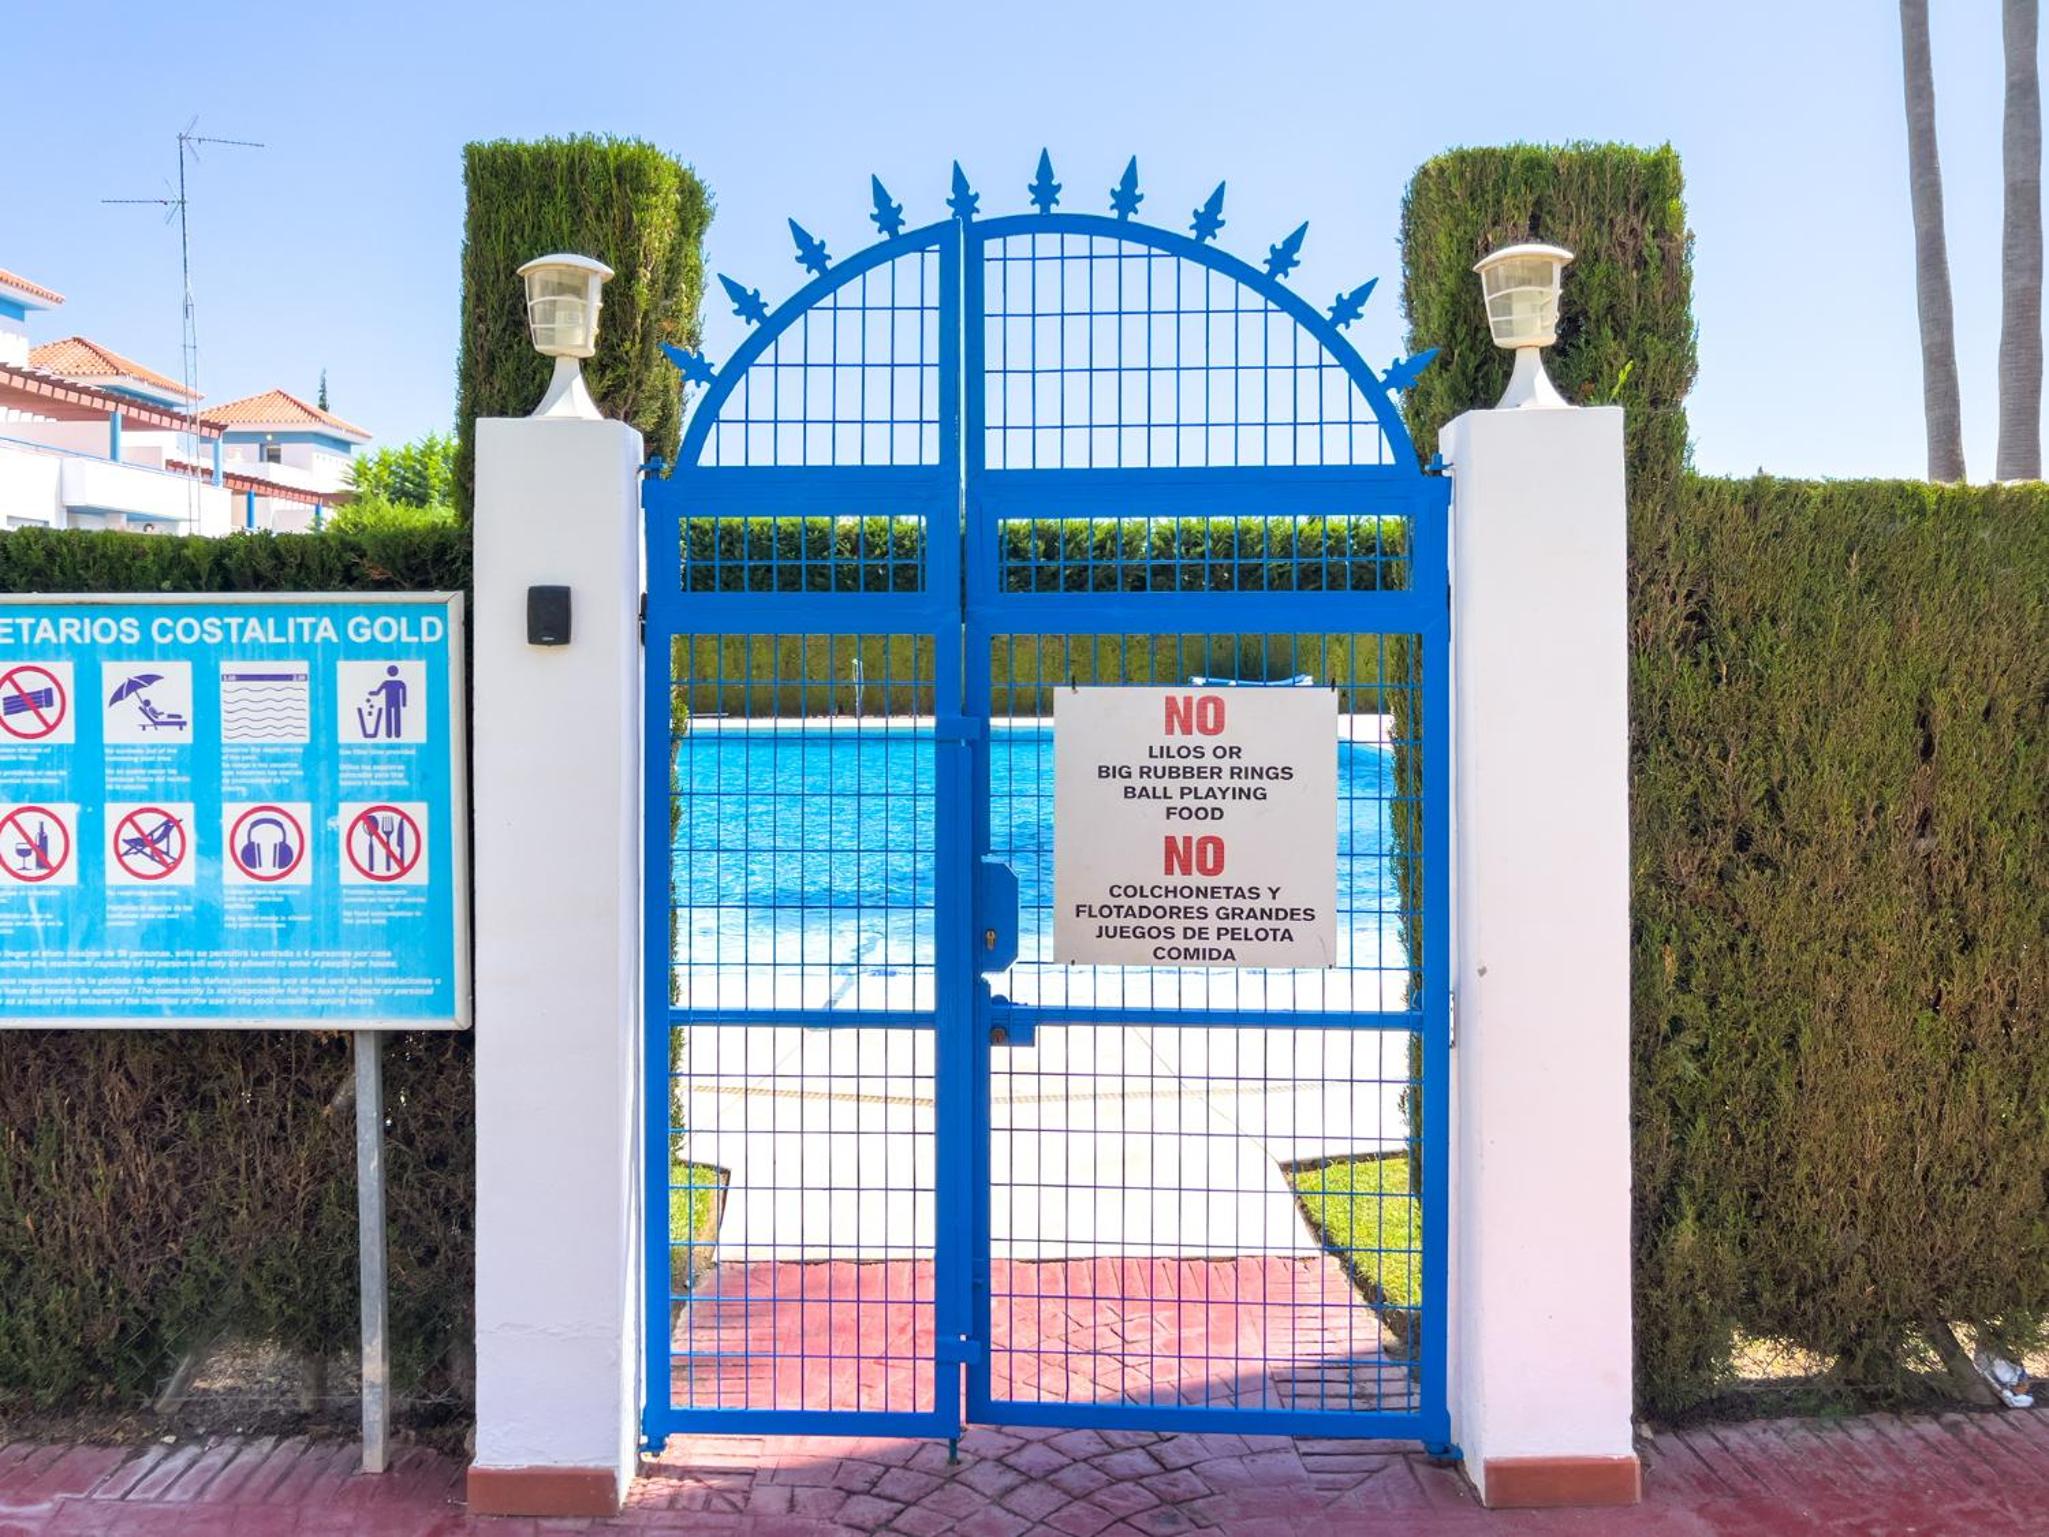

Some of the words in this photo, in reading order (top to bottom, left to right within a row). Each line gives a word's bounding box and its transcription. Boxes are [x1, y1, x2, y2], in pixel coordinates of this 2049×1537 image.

[151, 616, 339, 645] COSTALITA
[347, 615, 444, 644] GOLD
[1165, 695, 1226, 736] NO
[1148, 745, 1206, 760] LILOS
[1213, 746, 1242, 760] OR
[1097, 765, 1132, 780] BIG
[1139, 765, 1223, 781] RUBBER
[1229, 766, 1294, 781] RINGS
[1123, 786, 1173, 800] BALL
[1180, 786, 1268, 801] PLAYING
[1166, 806, 1225, 821] FOOD
[1164, 835, 1225, 877] NO
[1109, 884, 1261, 900] COLCHONETAS
[1268, 886, 1281, 900] Y
[1075, 904, 1209, 920] FLOTADORES
[1215, 906, 1316, 922] GRANDES
[1096, 925, 1176, 940] JUEGOS
[1183, 926, 1209, 941] DE
[1216, 927, 1294, 942] PELOTA
[1153, 946, 1236, 961] COMIDA
